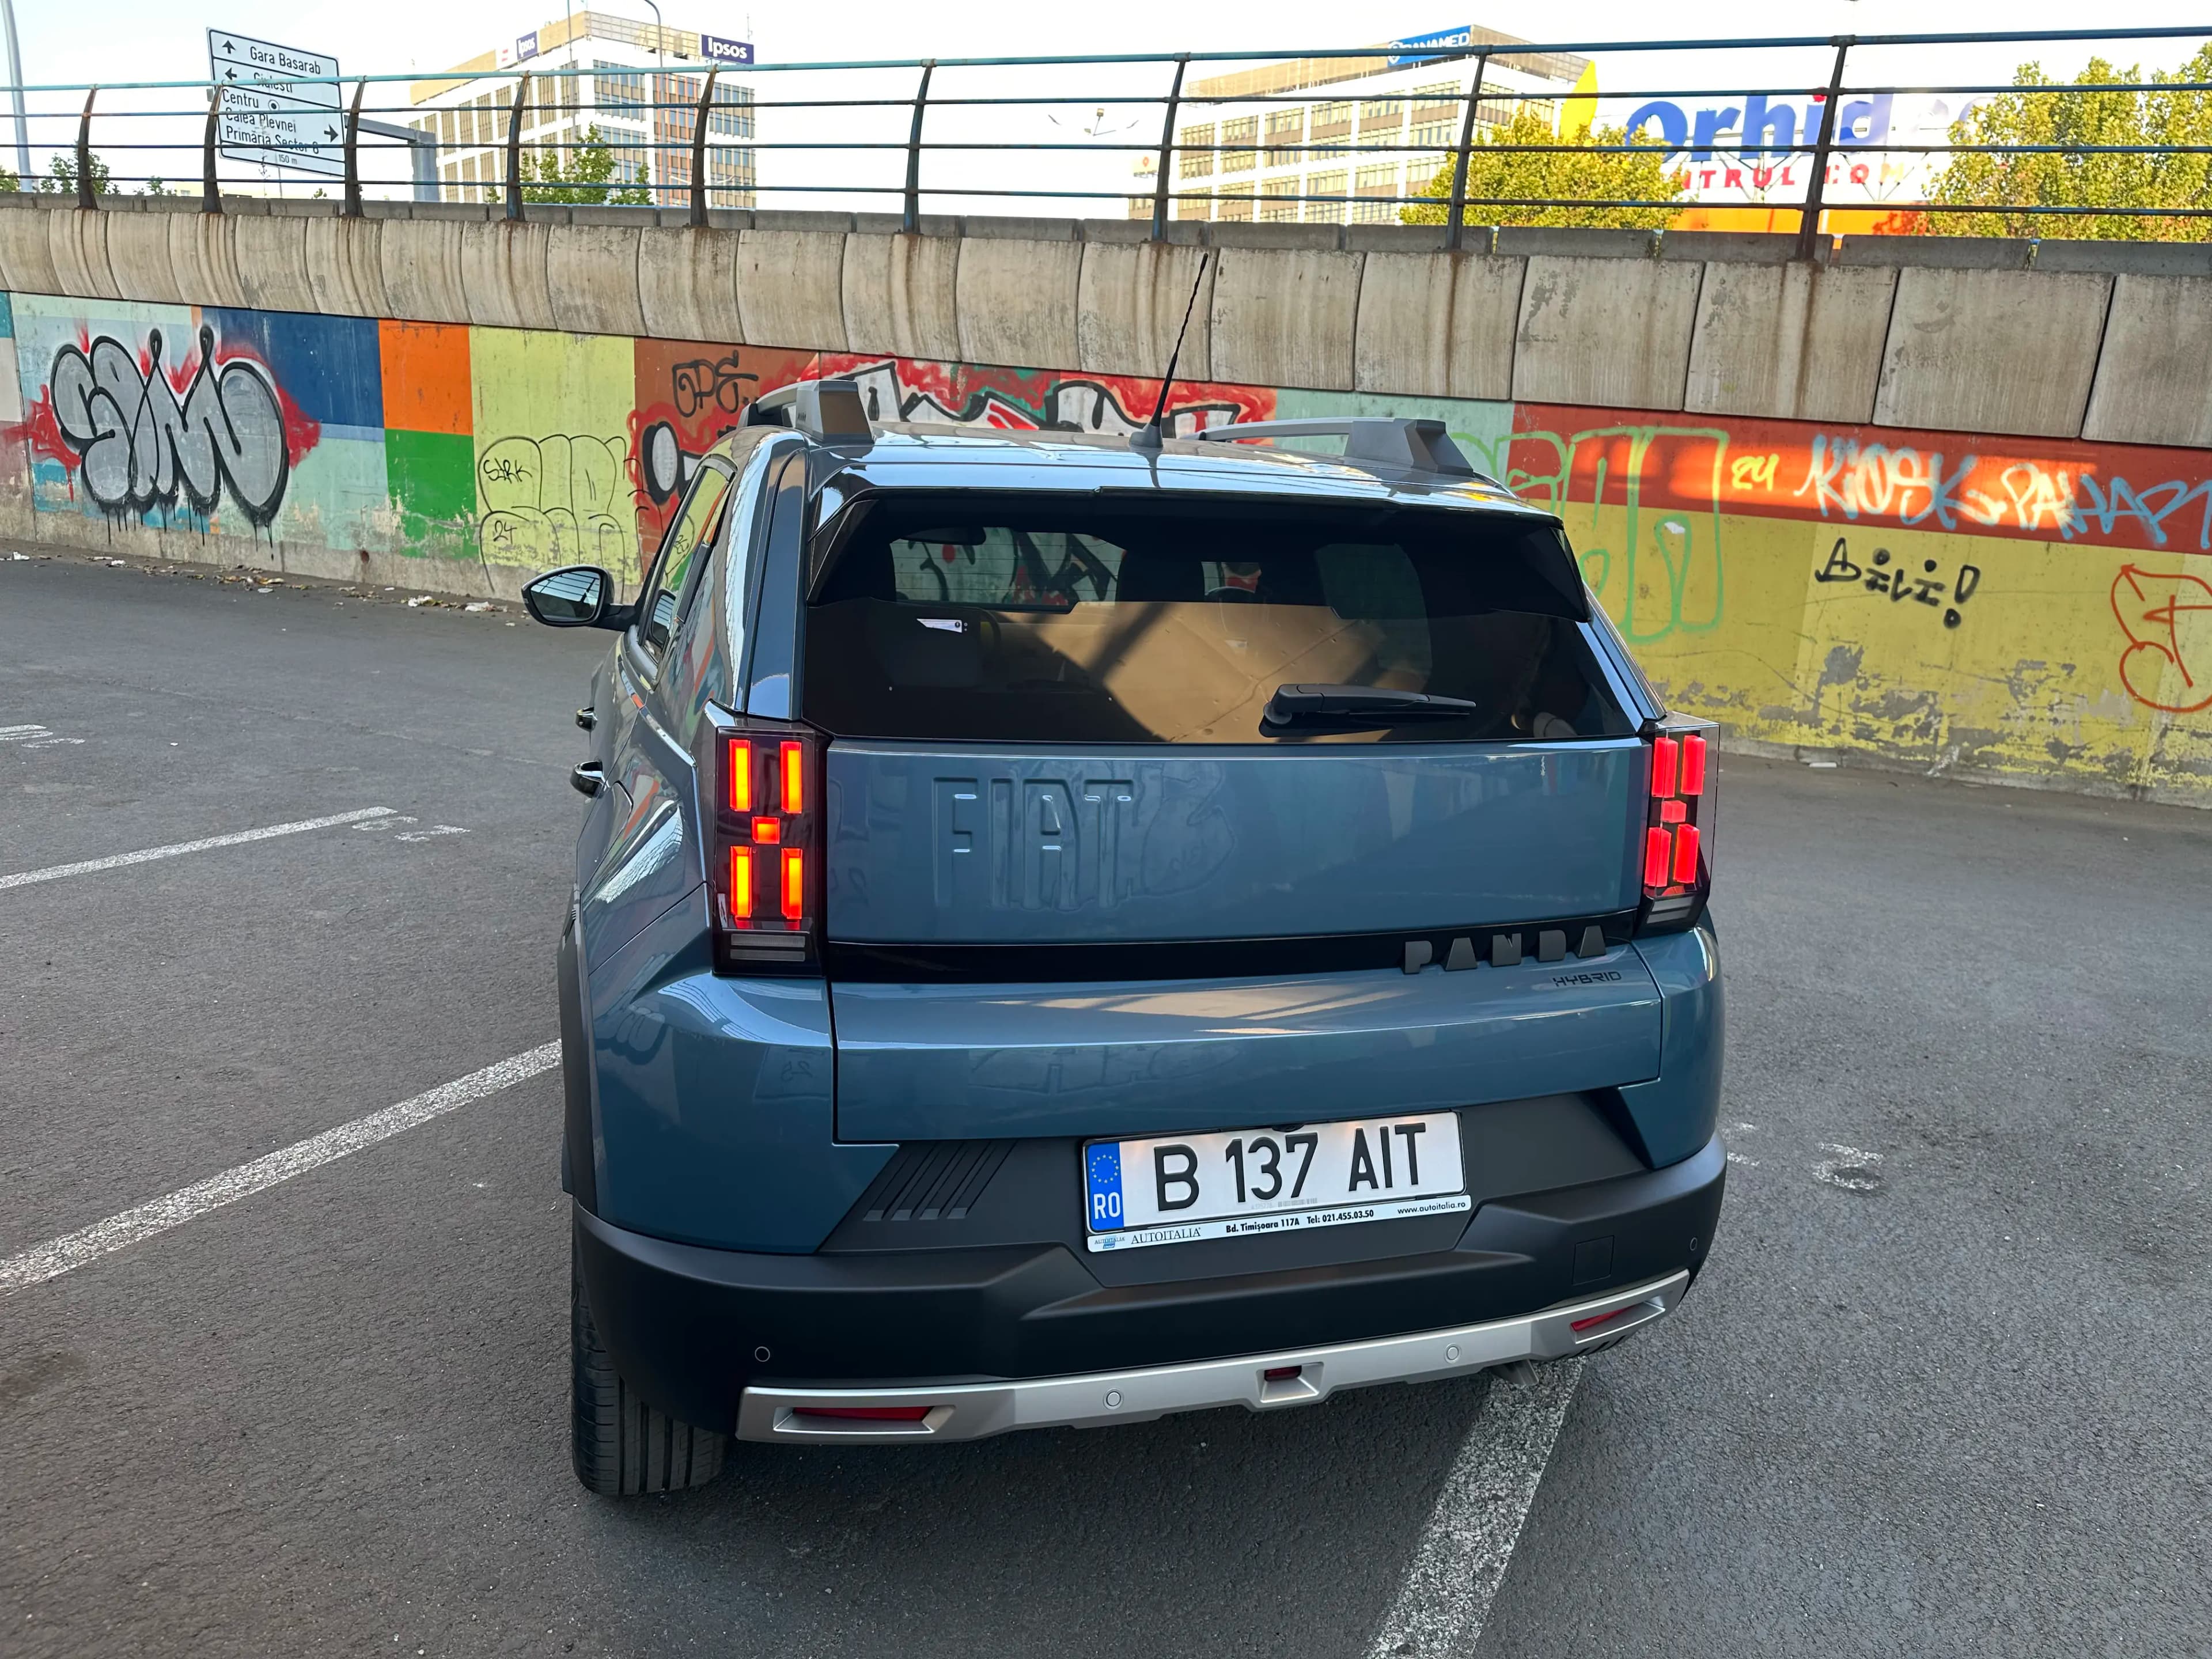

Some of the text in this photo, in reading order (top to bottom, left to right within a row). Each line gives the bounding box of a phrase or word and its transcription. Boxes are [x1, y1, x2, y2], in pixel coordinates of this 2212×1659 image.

[250, 46, 321, 75] Gara Basarab
[708, 37, 747, 59] Ipsos
[222, 88, 259, 109] Centru
[226, 107, 297, 133] Calea Plevnei
[279, 154, 290, 164] 150
[493, 520, 518, 544] 24
[932, 777, 1134, 911] FIAT
[1403, 925, 1607, 975] PANDA
[1552, 971, 1622, 987] HYBRID
[1154, 1122, 1426, 1211] B 137 AIT
[1094, 1192, 1121, 1219] RO
[1226, 1224, 1238, 1233] Bd.
[1281, 1218, 1300, 1227] 117A
[1306, 1215, 1320, 1224] Tel:
[1322, 1210, 1374, 1222] 021.455.03.50
[1397, 1202, 1466, 1214] www.autoitalia.ro
